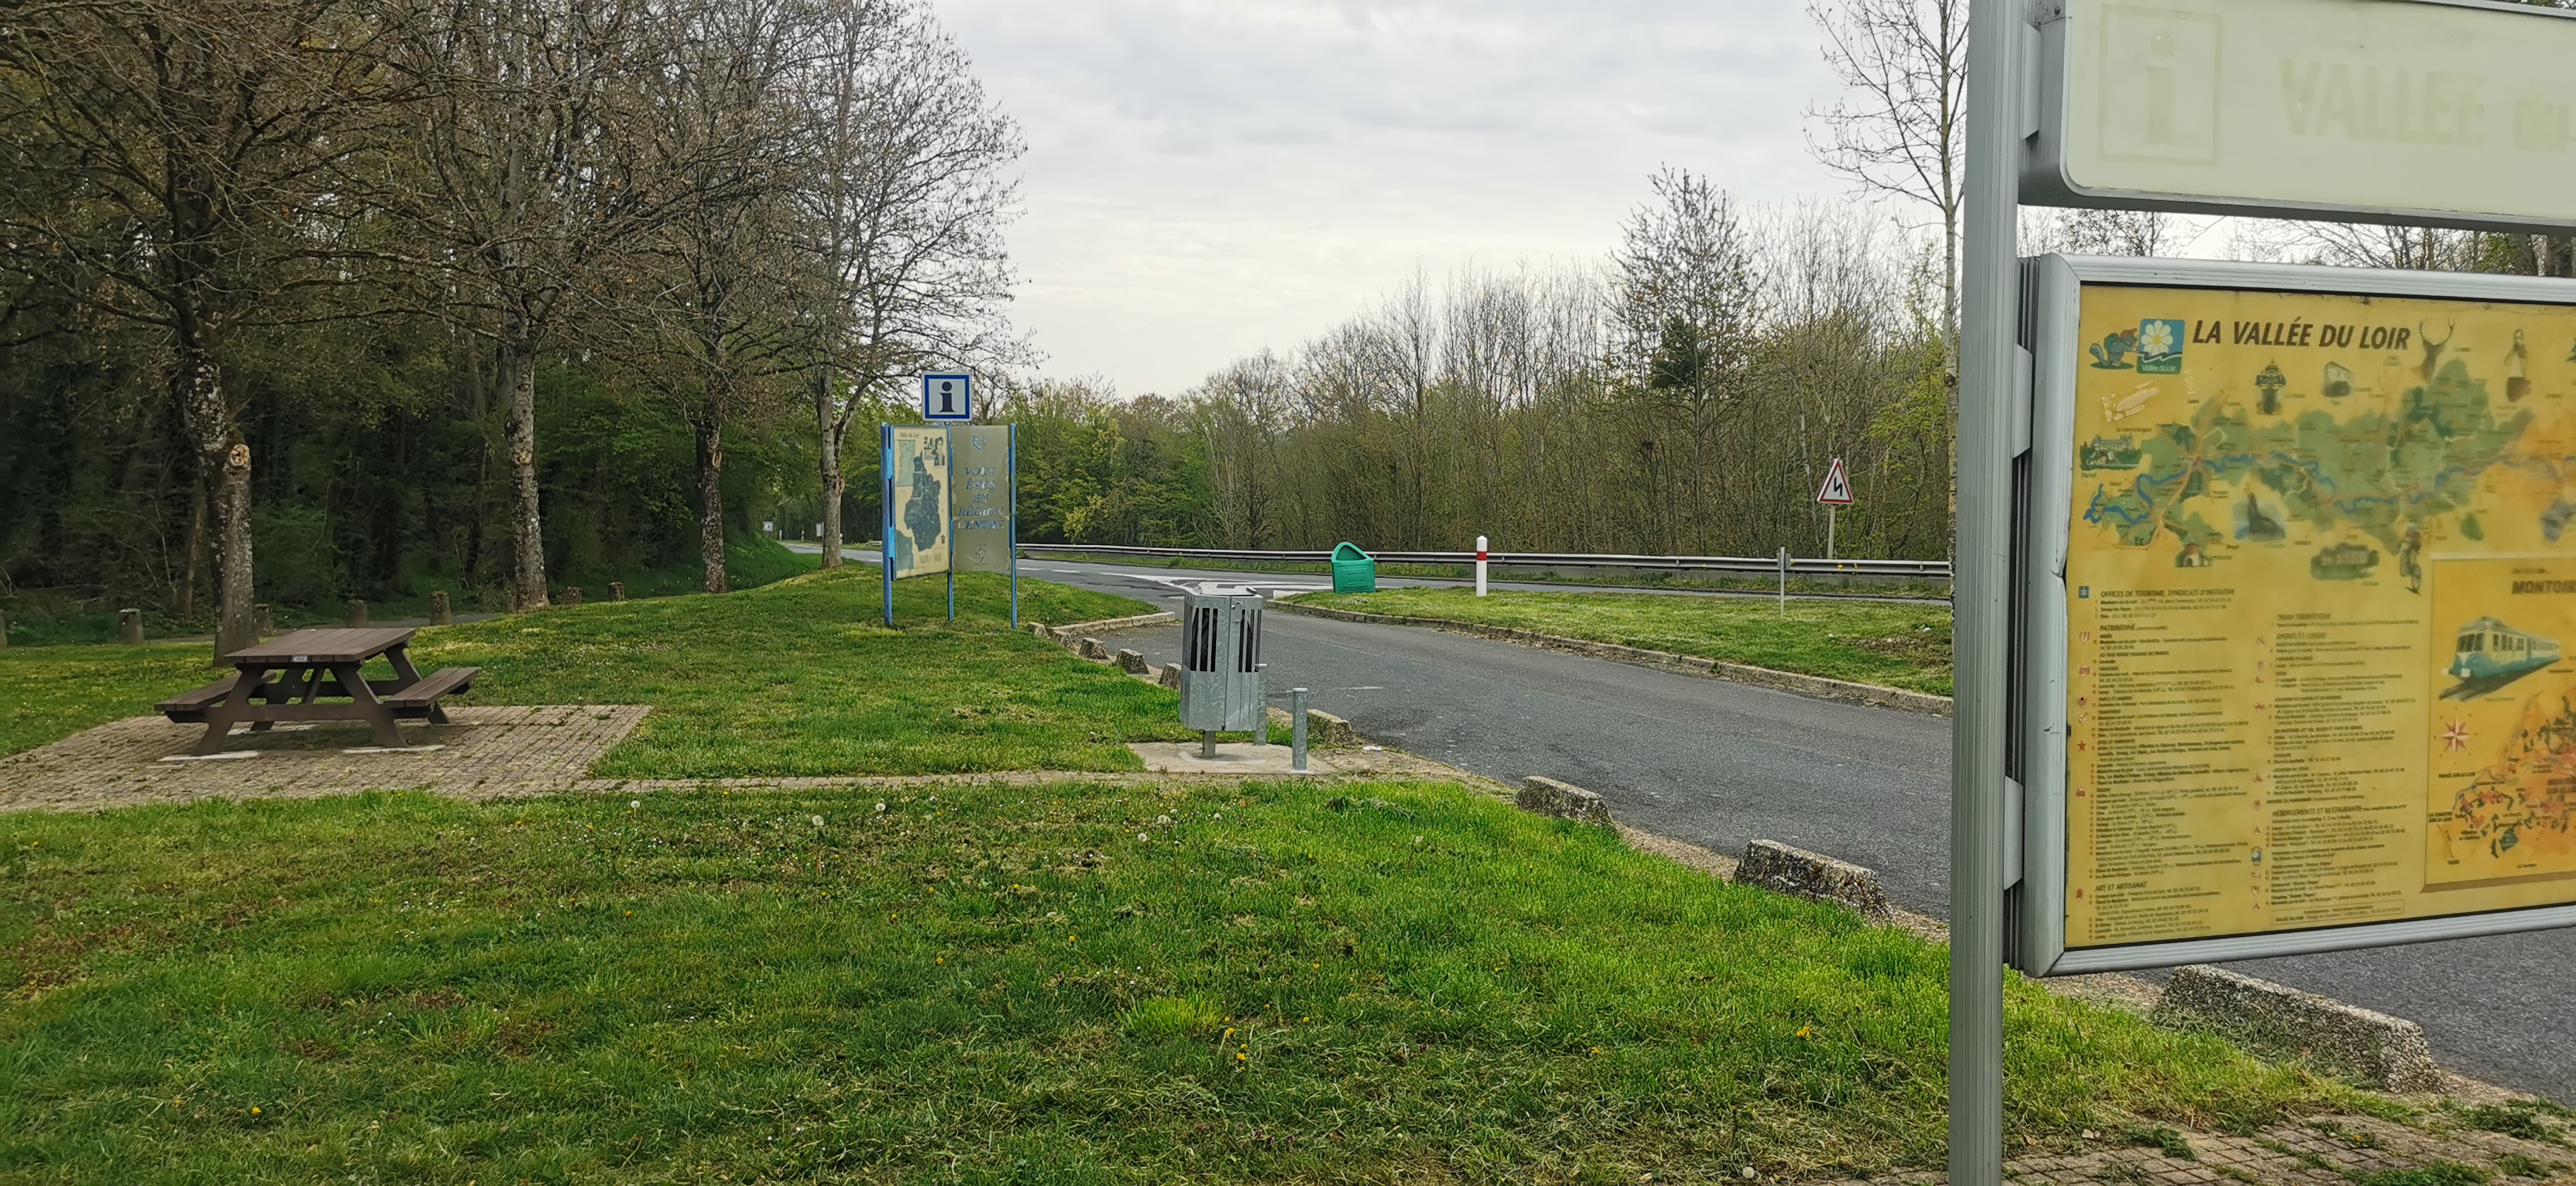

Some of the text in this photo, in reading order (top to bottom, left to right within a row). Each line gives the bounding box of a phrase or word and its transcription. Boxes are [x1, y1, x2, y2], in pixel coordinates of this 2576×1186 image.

[2192, 316, 2411, 350] LA VALLÉE DU LOIR
[965, 467, 995, 477] VOUS
[965, 478, 996, 490] ÊTES
[973, 494, 989, 503] EN
[958, 505, 1003, 517] RÉGION
[958, 520, 1003, 530] CENTRE
[2116, 881, 2148, 890] ARTISANAT
